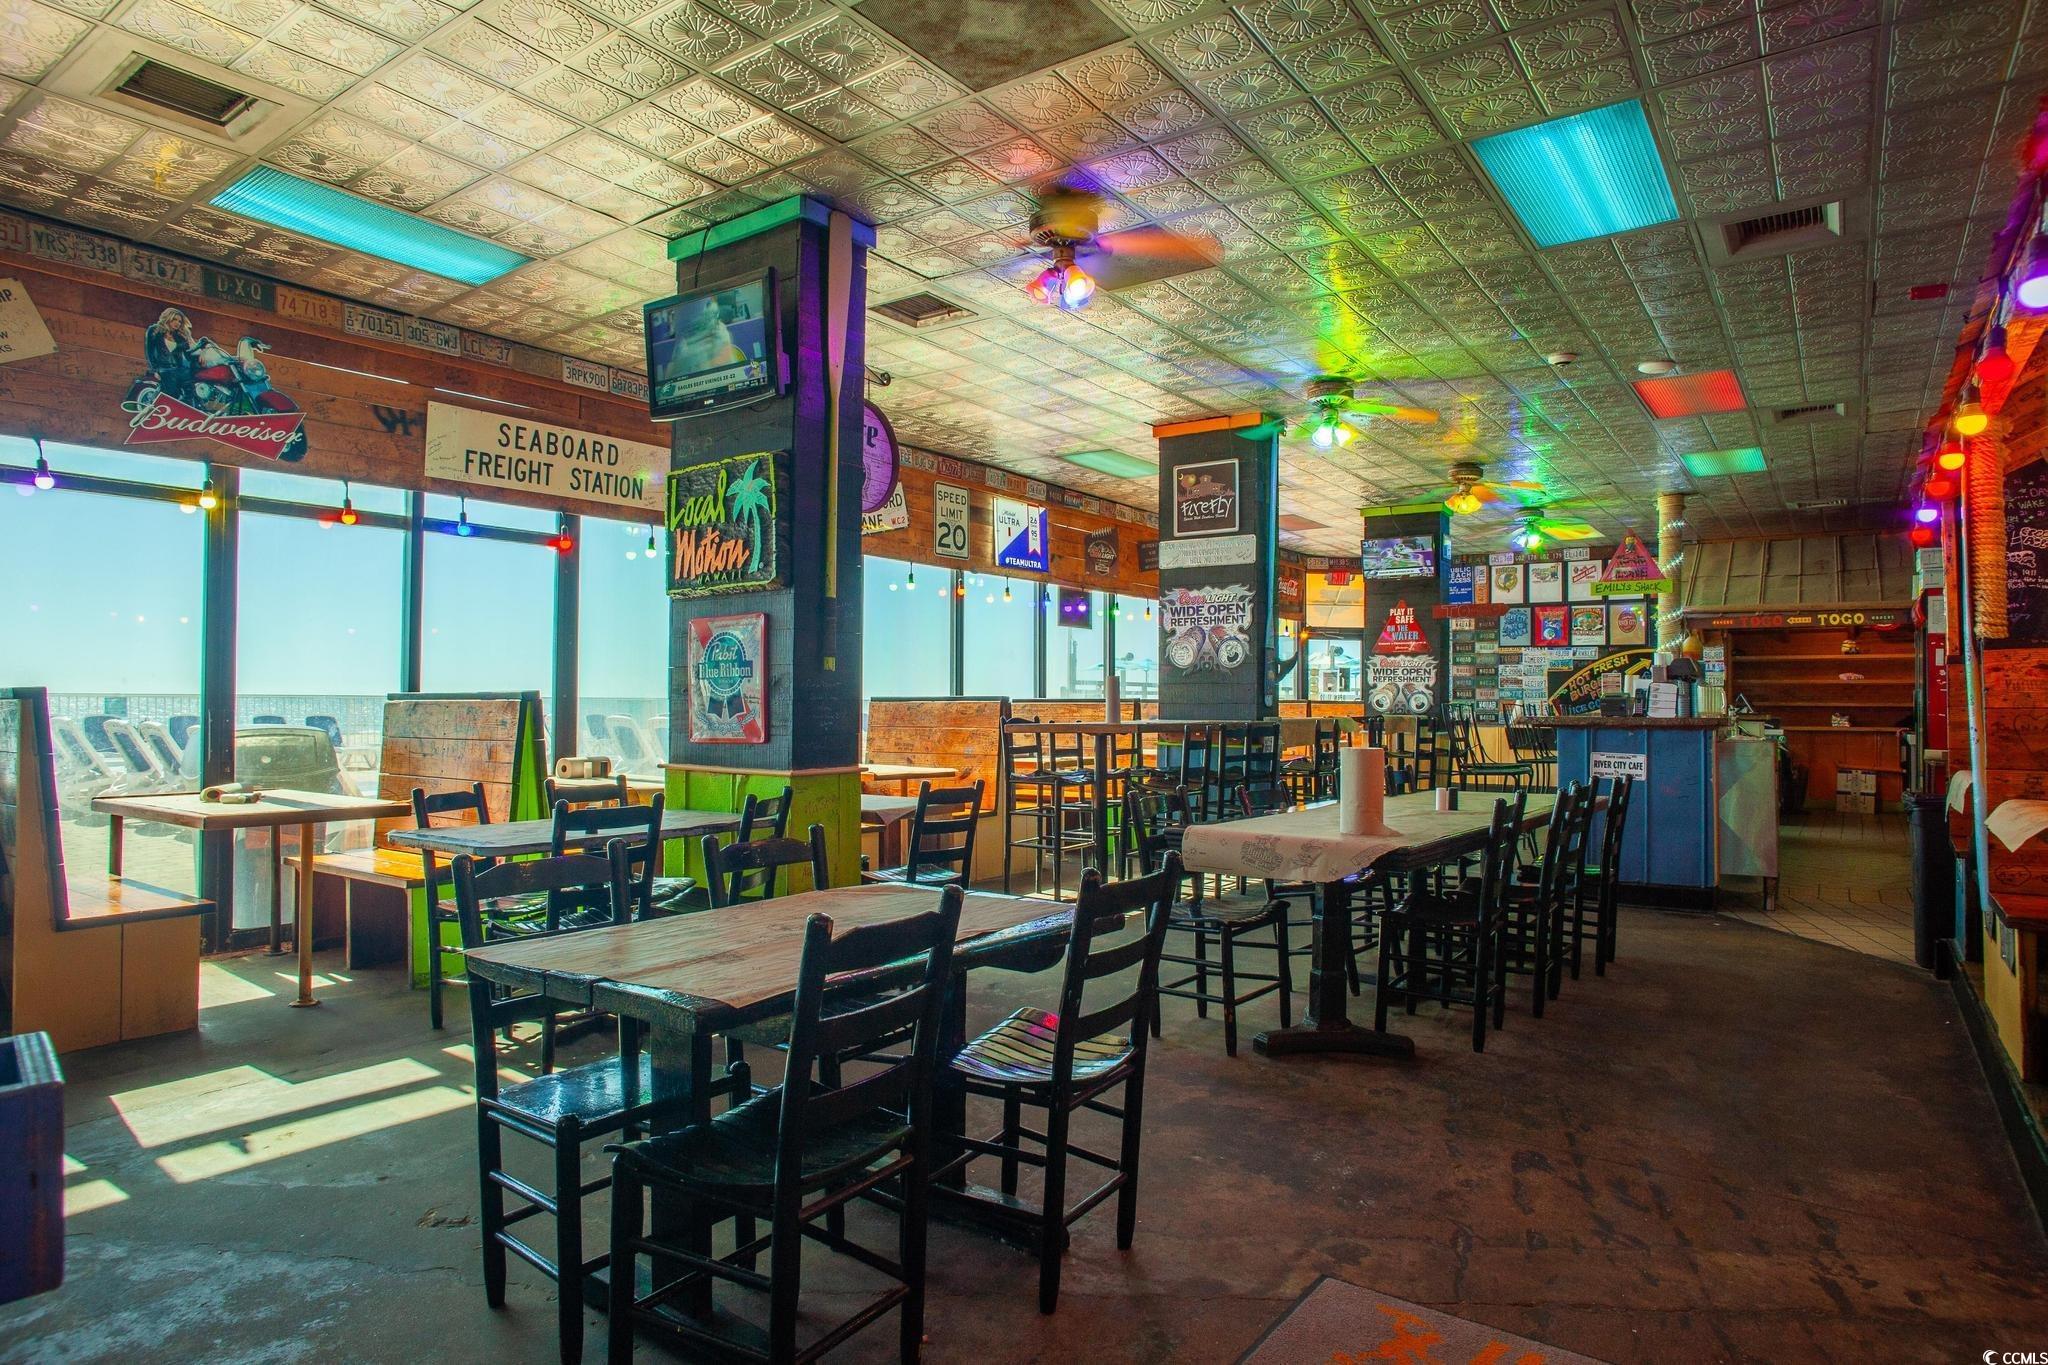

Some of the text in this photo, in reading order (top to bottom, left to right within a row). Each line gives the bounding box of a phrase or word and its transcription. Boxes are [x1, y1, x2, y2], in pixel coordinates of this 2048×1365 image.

[565, 366, 606, 388] 3RPK900
[120, 400, 303, 445] Budweiser
[497, 422, 619, 466] SEABOARD
[464, 449, 644, 501] FREIGHT STATION
[671, 469, 728, 532] Local
[937, 490, 967, 506] SPEED
[940, 506, 963, 521] LIMIT
[998, 515, 1021, 527] ULTRA
[937, 521, 967, 551] 20
[675, 526, 750, 580] Motion
[1005, 557, 1042, 569] #TEAMULTRA
[1206, 592, 1237, 604] LIGHT
[1170, 602, 1246, 618] WIDE OPEN
[1389, 608, 1405, 616] PLAY
[1170, 614, 1246, 627] REFRESHMENT
[1395, 615, 1415, 624] SAFE
[1817, 612, 1865, 626] TOGO
[1392, 631, 1419, 641] WATER
[710, 641, 739, 661] Pabst
[698, 661, 752, 679] Blue Ribbon
[1401, 659, 1425, 668] LIGHT
[1372, 668, 1432, 676] WIDE OPEN
[1372, 675, 1431, 684] REFRESHMENT
[1569, 654, 1630, 692] HOT FRESH
[1593, 759, 1644, 771] RIVER CITY CAFE
